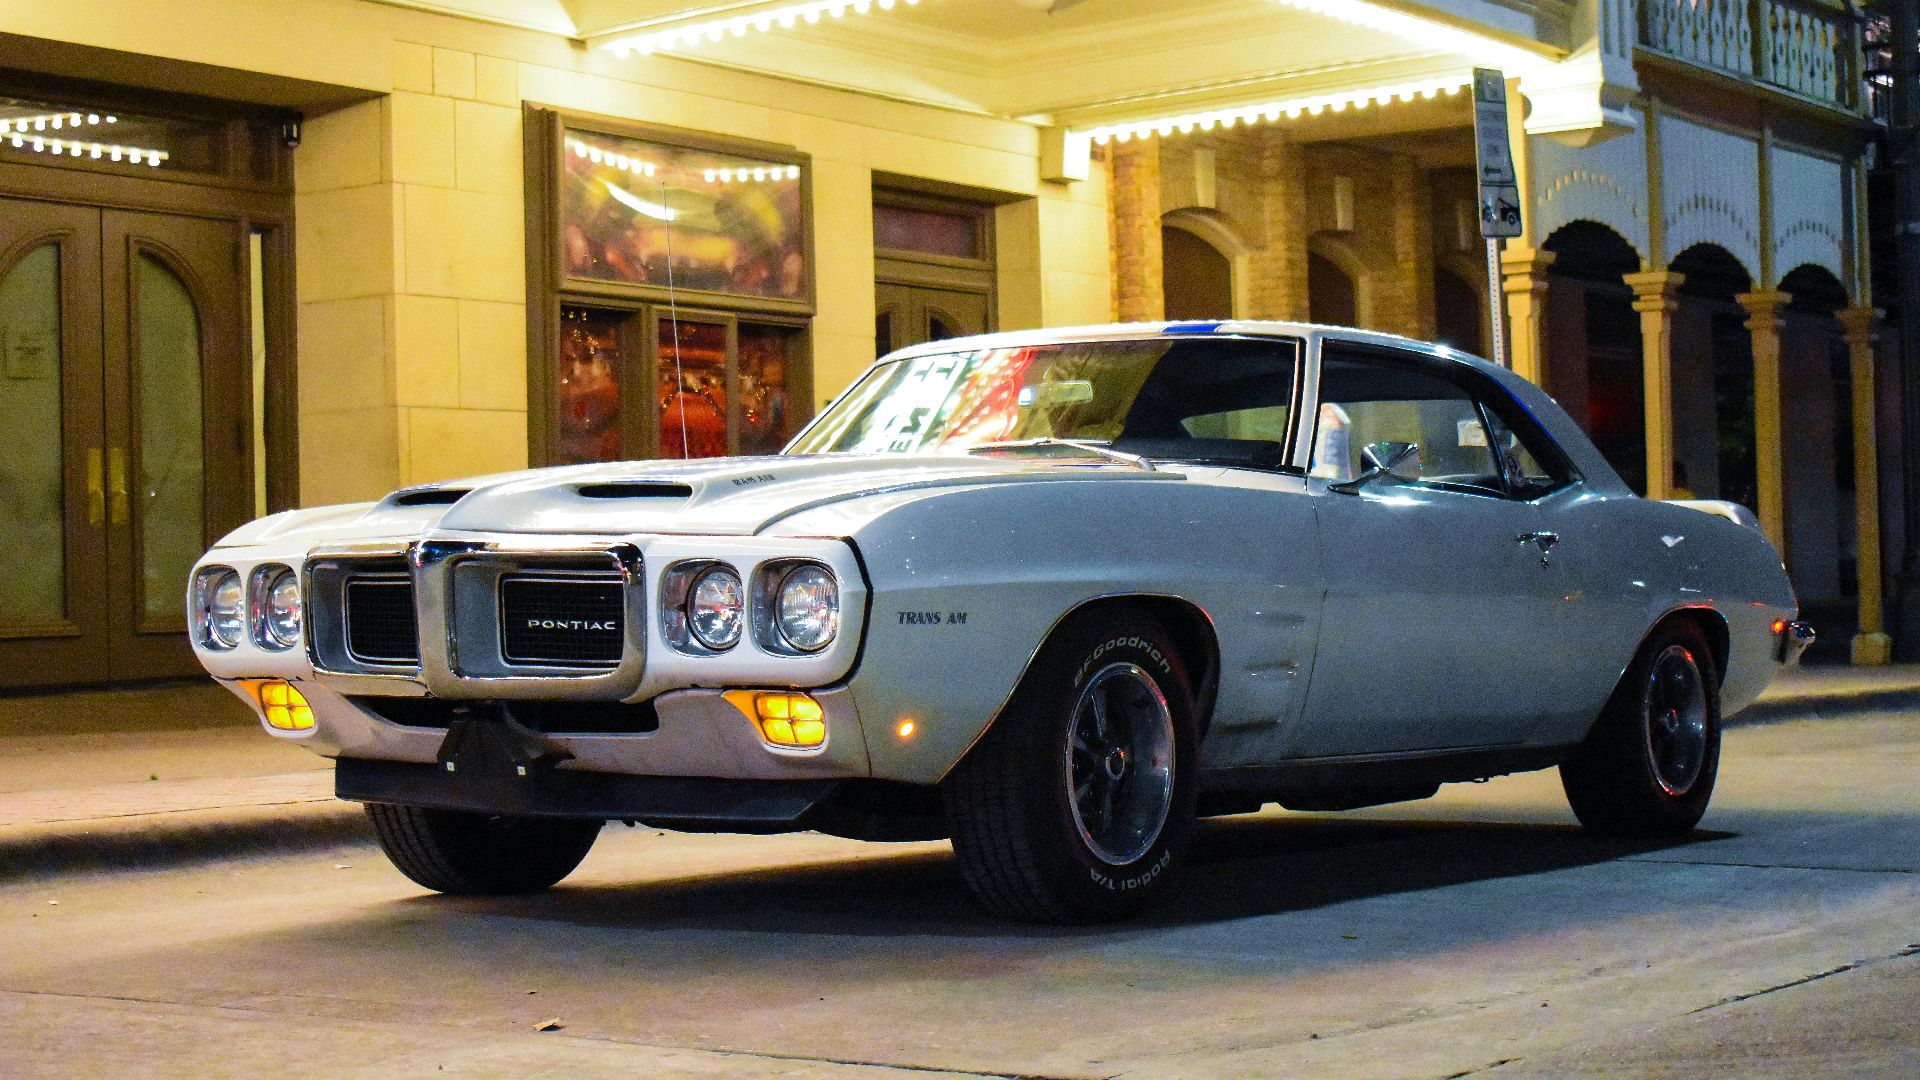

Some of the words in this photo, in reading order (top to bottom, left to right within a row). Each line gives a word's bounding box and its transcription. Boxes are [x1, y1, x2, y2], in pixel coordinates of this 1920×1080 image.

[527, 619, 616, 630] PONTIAC
[897, 611, 941, 625] TRANS
[946, 612, 967, 625] AM
[1074, 636, 1171, 688] BFGoodrich
